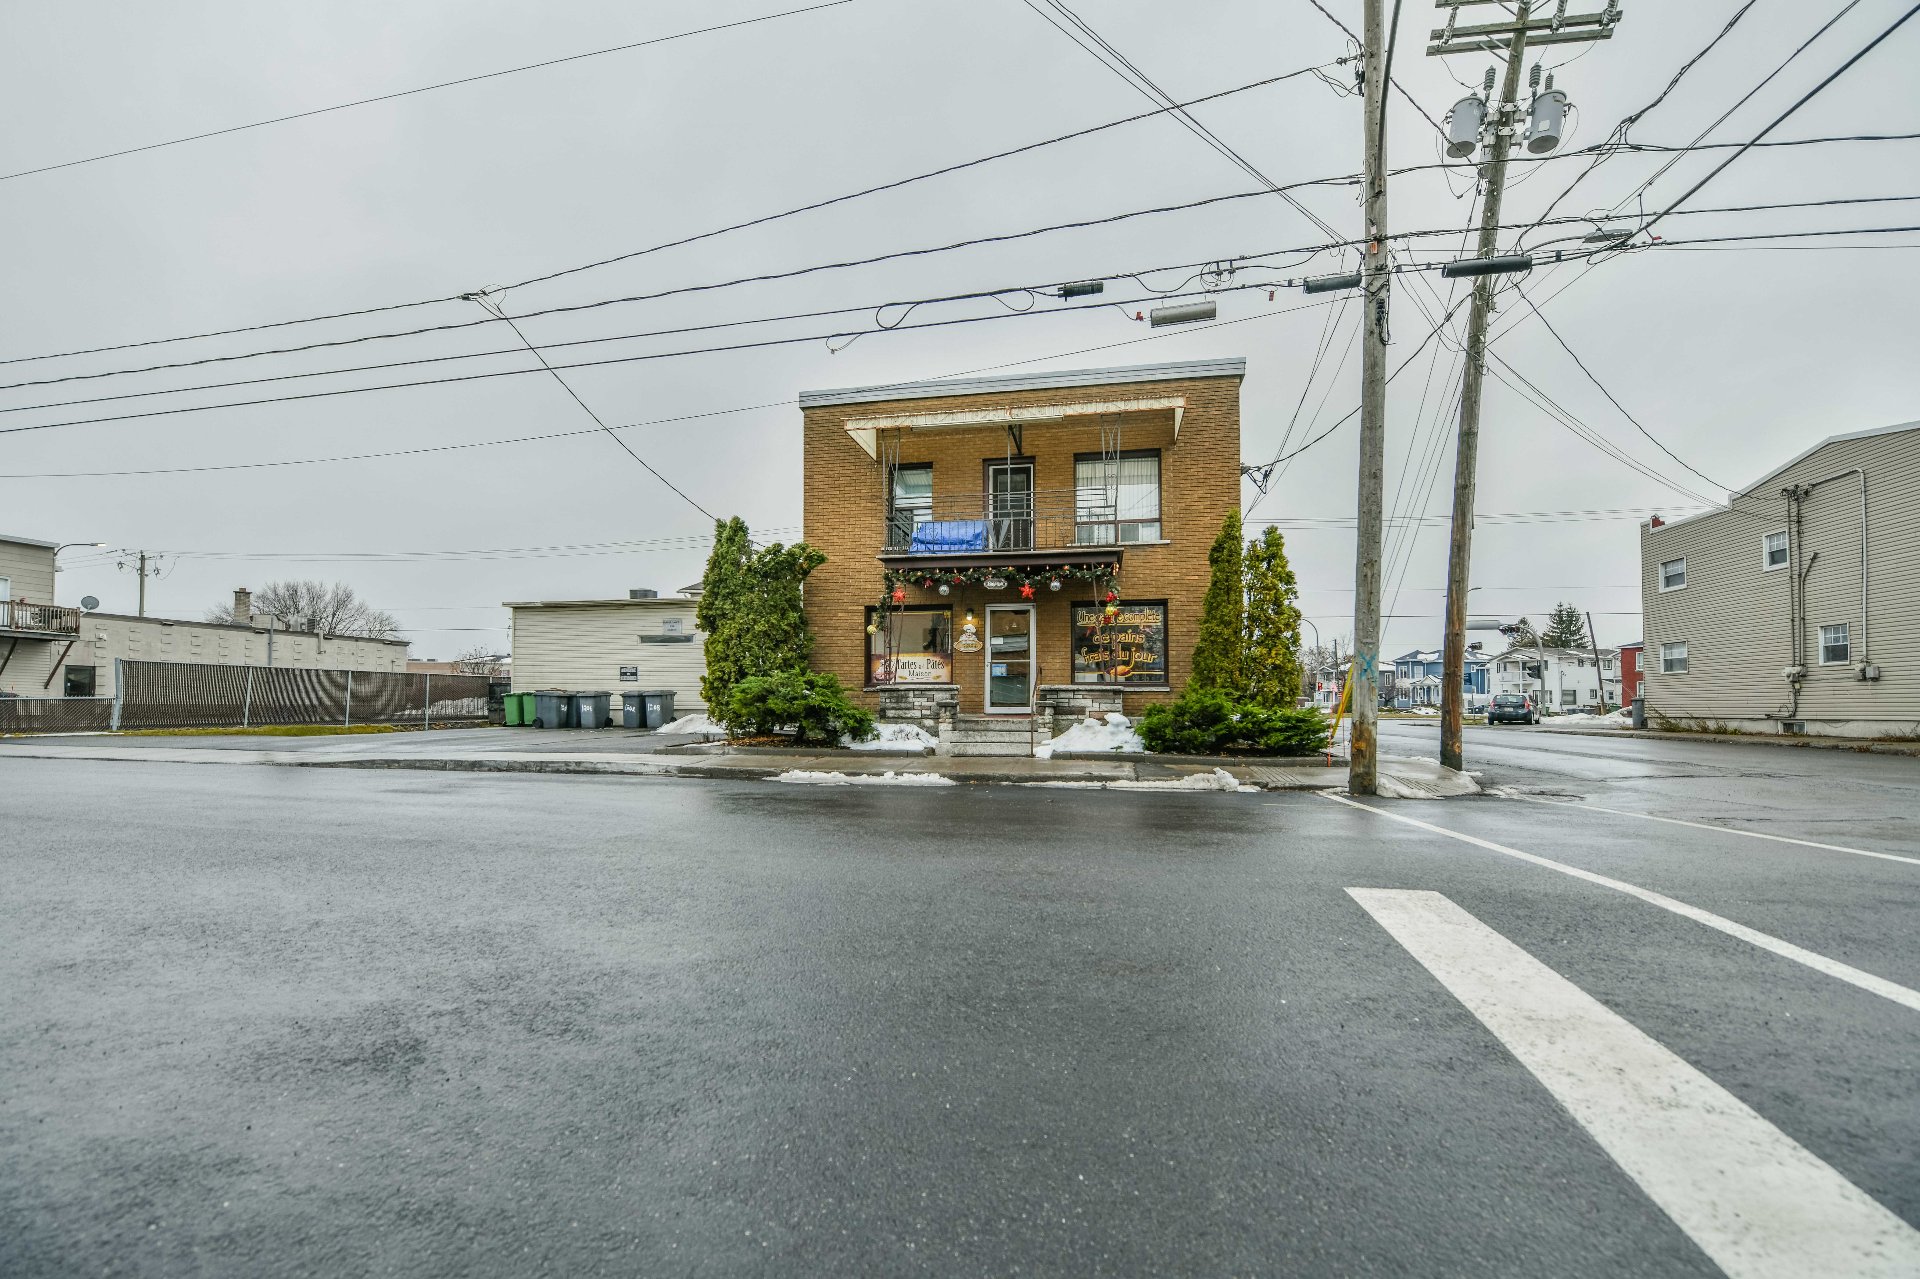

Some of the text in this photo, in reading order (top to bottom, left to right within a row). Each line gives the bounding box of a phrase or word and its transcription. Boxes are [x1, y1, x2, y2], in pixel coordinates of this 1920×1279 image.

[1124, 607, 1161, 628] complète
[1093, 627, 1146, 649] de pains
[896, 658, 917, 669] Tartes
[926, 658, 945, 669] Pâtés
[1112, 643, 1129, 660] du
[1129, 646, 1158, 668] jour
